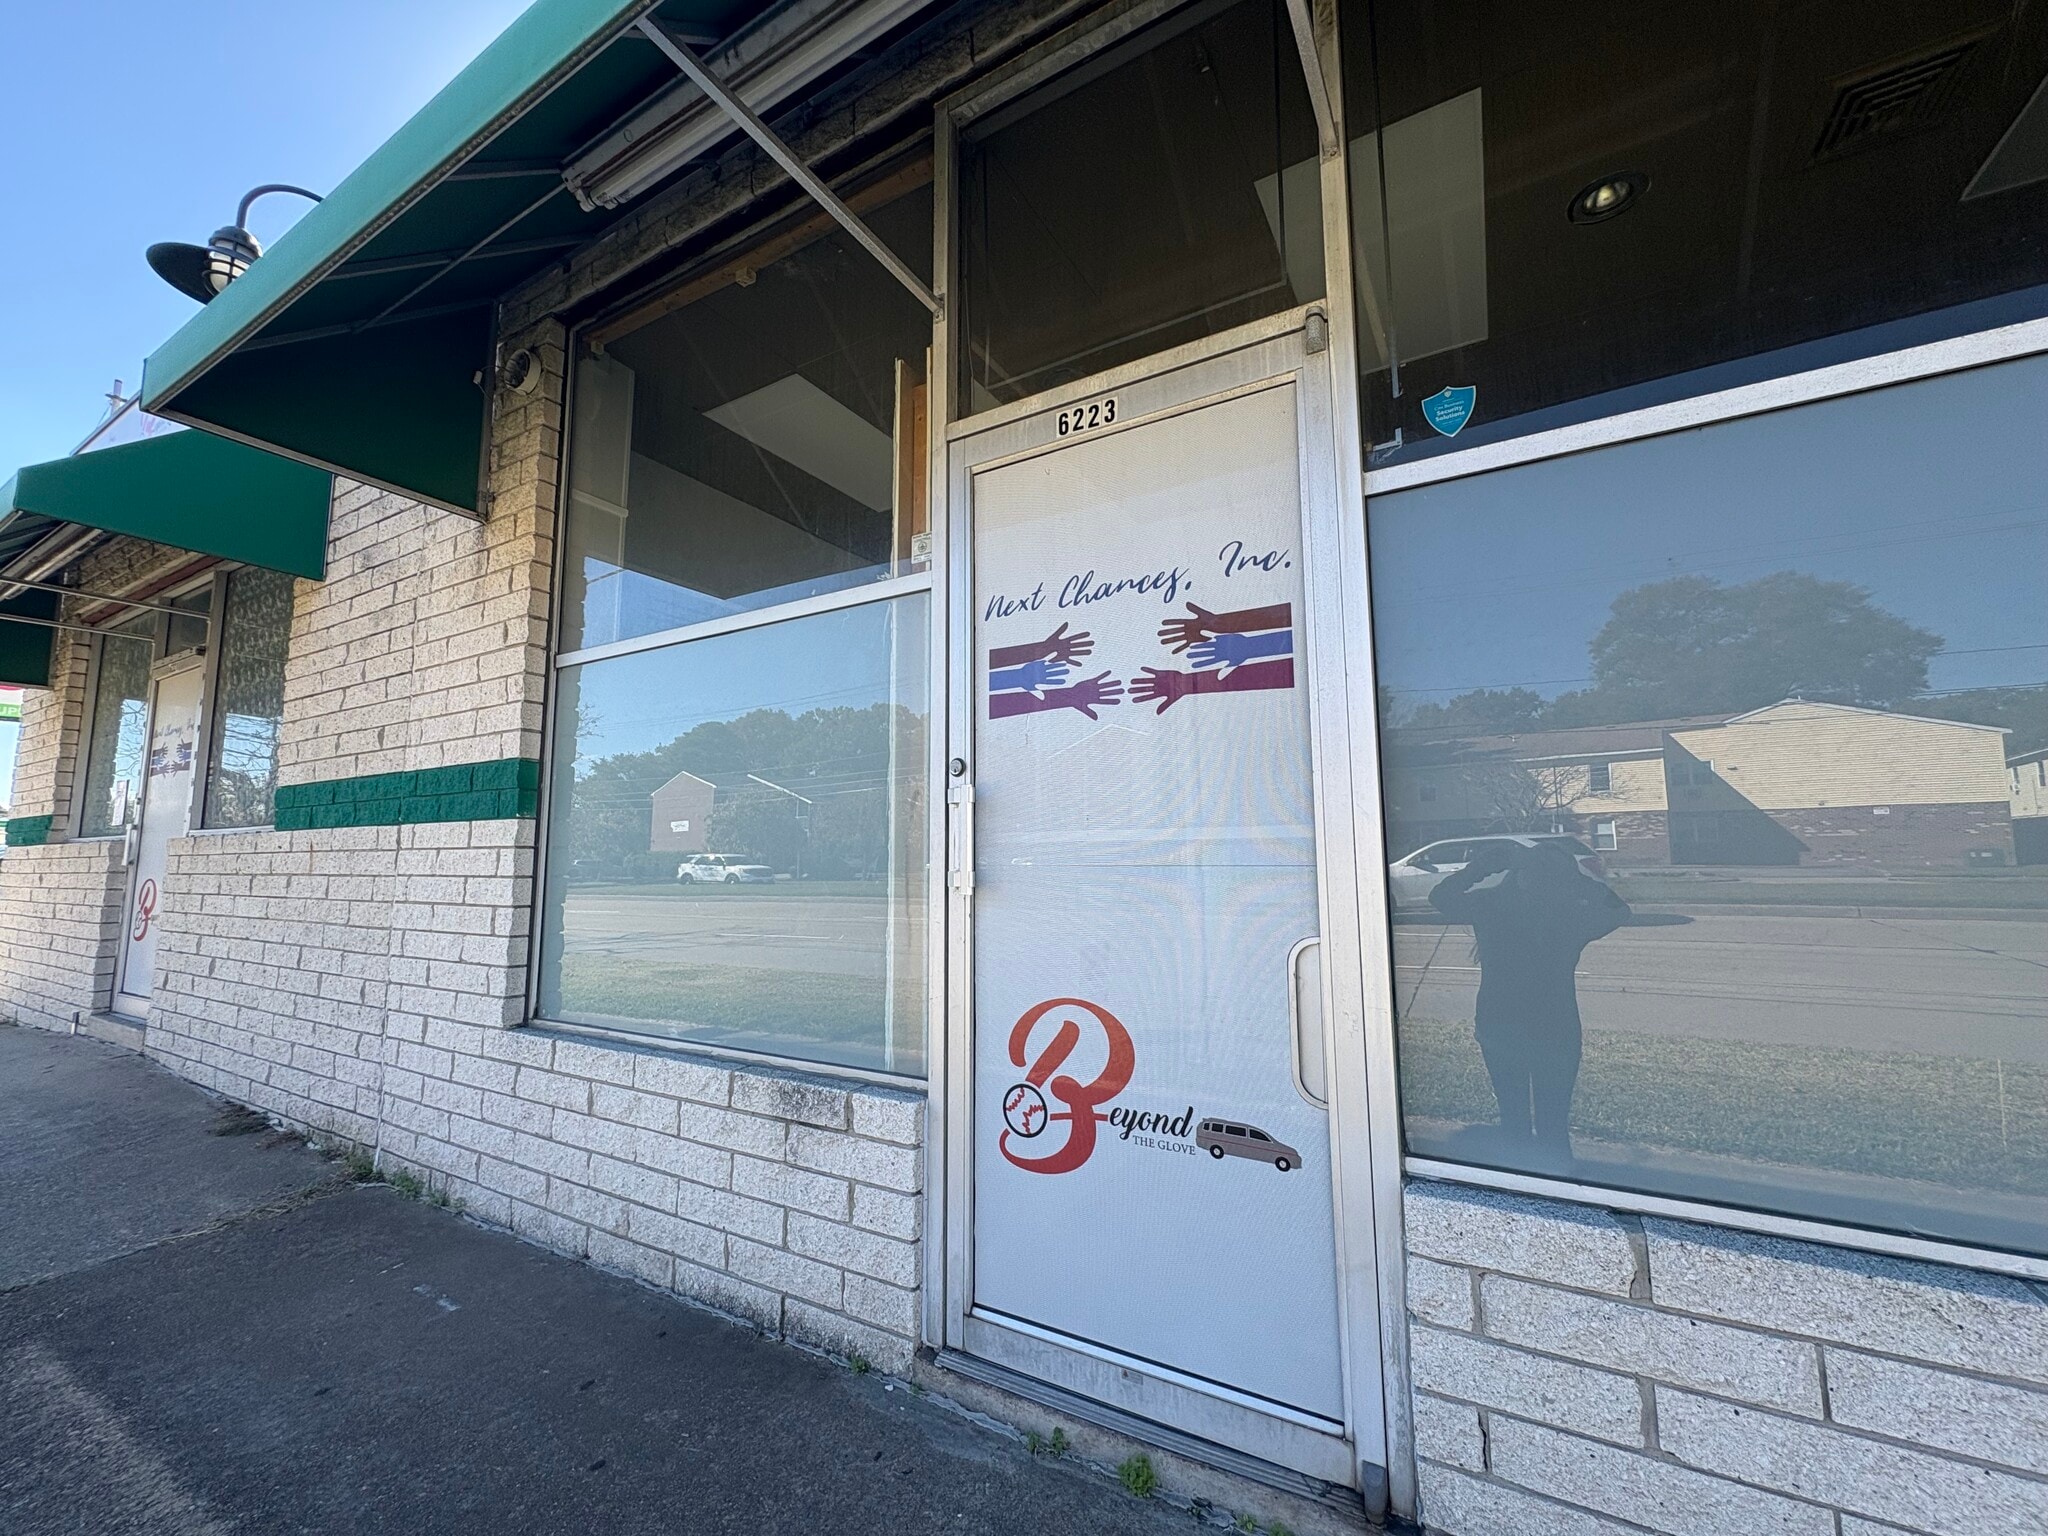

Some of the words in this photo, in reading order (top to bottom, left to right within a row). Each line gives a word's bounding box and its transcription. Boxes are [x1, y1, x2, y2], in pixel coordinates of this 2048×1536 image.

[1057, 399, 1115, 435] 6223
[1435, 411, 1465, 422] Solutions
[1436, 405, 1463, 416] Security
[985, 582, 1046, 622] Next
[1218, 540, 1292, 578] Inc.
[999, 998, 1194, 1174] Beyond
[1132, 1134, 1155, 1149] THE
[1157, 1139, 1196, 1156] GLOVE
